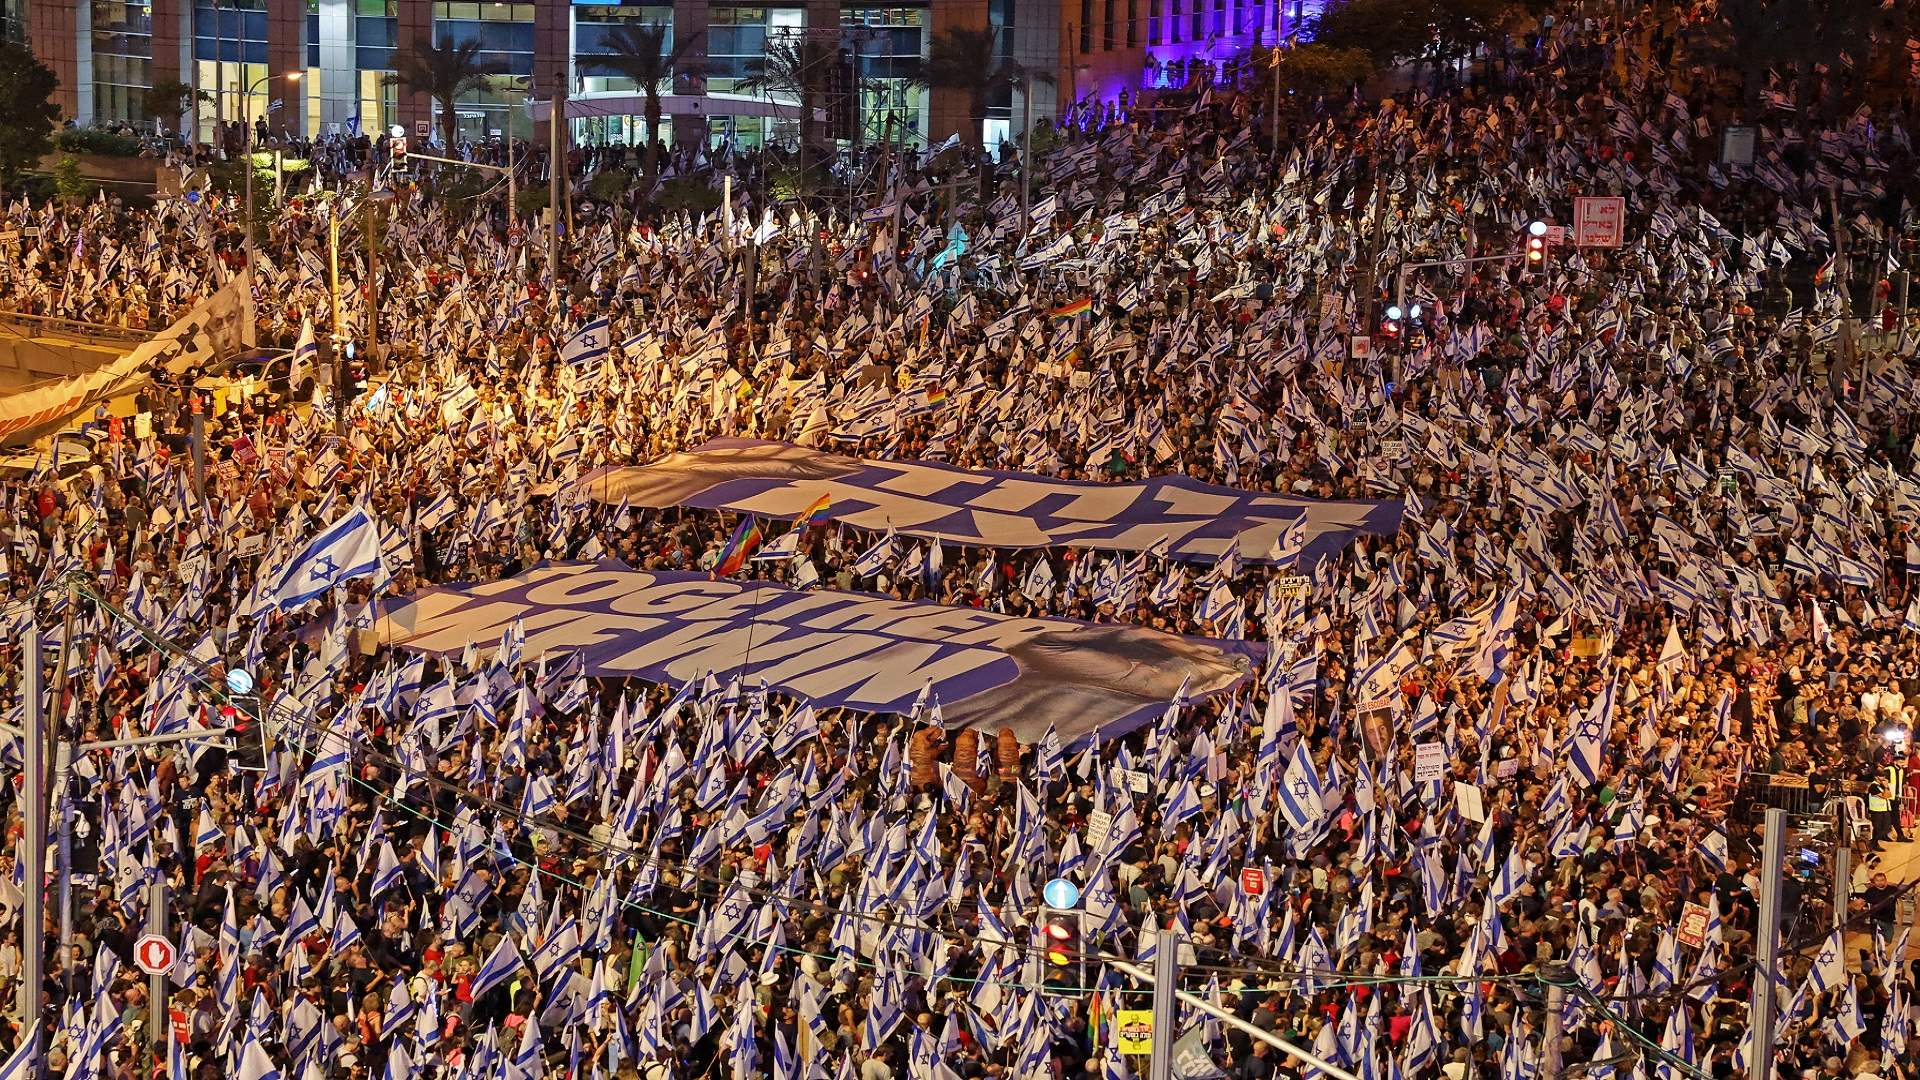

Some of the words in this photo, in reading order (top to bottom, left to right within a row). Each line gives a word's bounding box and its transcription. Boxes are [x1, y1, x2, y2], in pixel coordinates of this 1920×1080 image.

[861, 458, 1378, 525] ביחד
[374, 592, 672, 662] WE
[462, 564, 1087, 650] TOGETHER
[598, 618, 1012, 704] WIN
[1368, 697, 1391, 709] ESCOBAR
